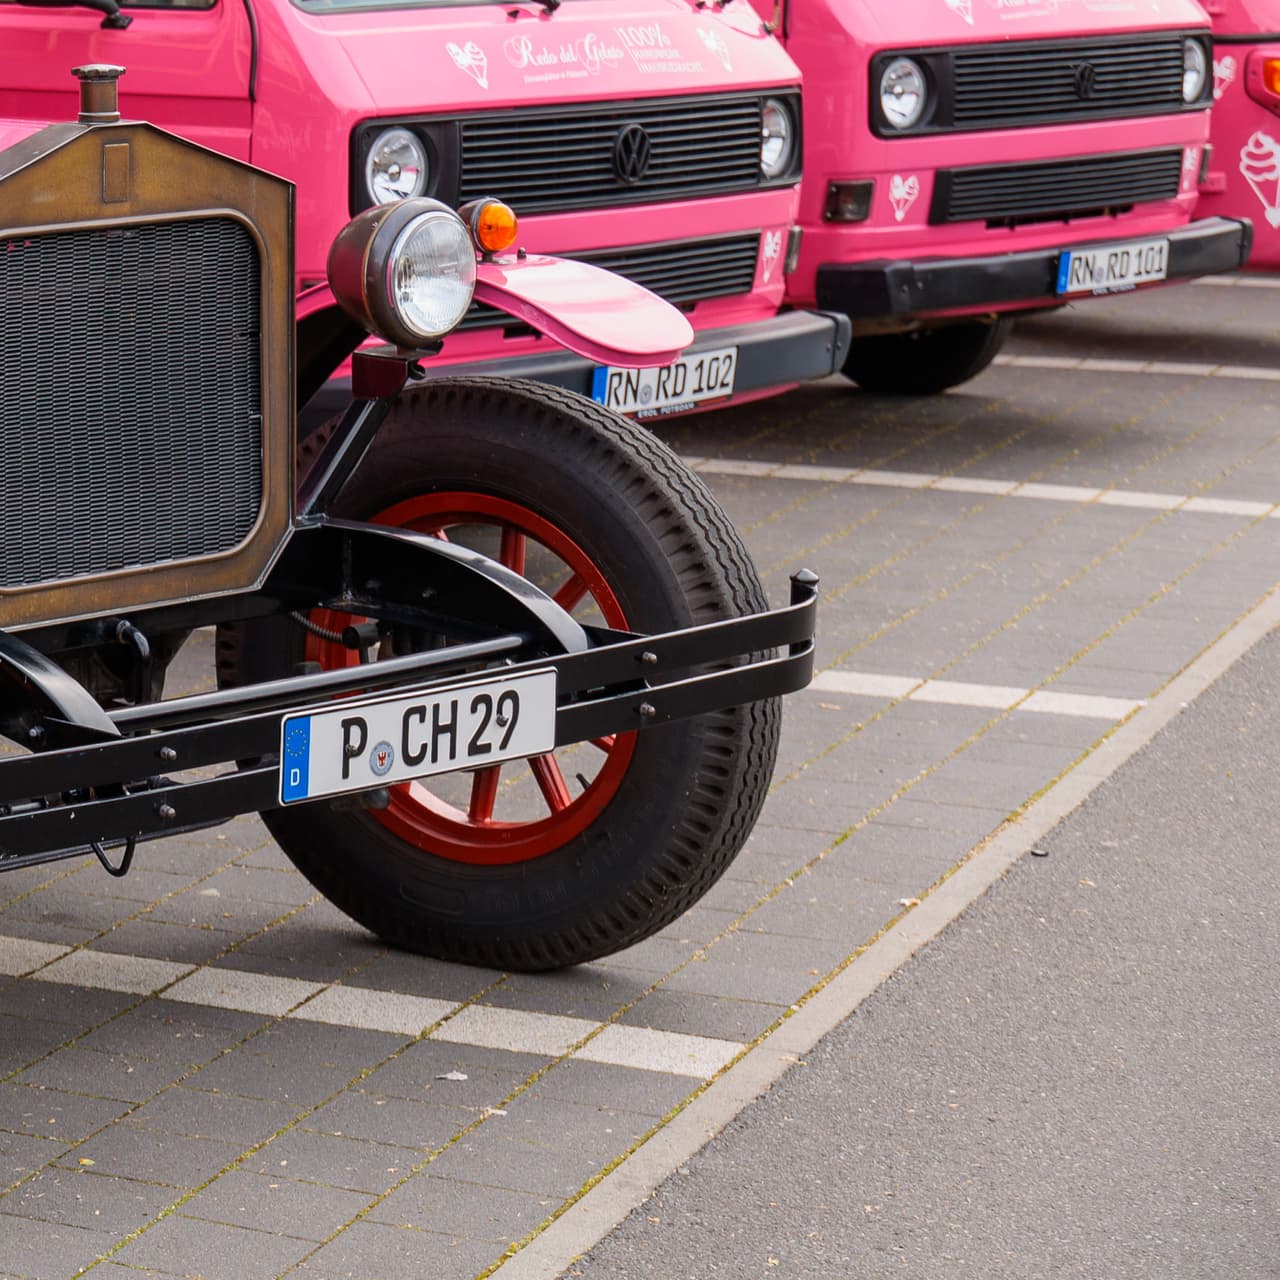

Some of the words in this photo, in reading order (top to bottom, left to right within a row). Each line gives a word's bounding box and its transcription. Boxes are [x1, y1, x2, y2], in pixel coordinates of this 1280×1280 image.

[1069, 255, 1096, 285] RN
[1106, 250, 1130, 281] RD
[1134, 245, 1164, 276] 101
[607, 369, 640, 407] RN
[656, 363, 687, 401] RD
[693, 355, 732, 395] 102
[341, 716, 368, 780] P
[401, 699, 459, 767] CH
[467, 689, 521, 757] 29
[290, 769, 300, 786] D
